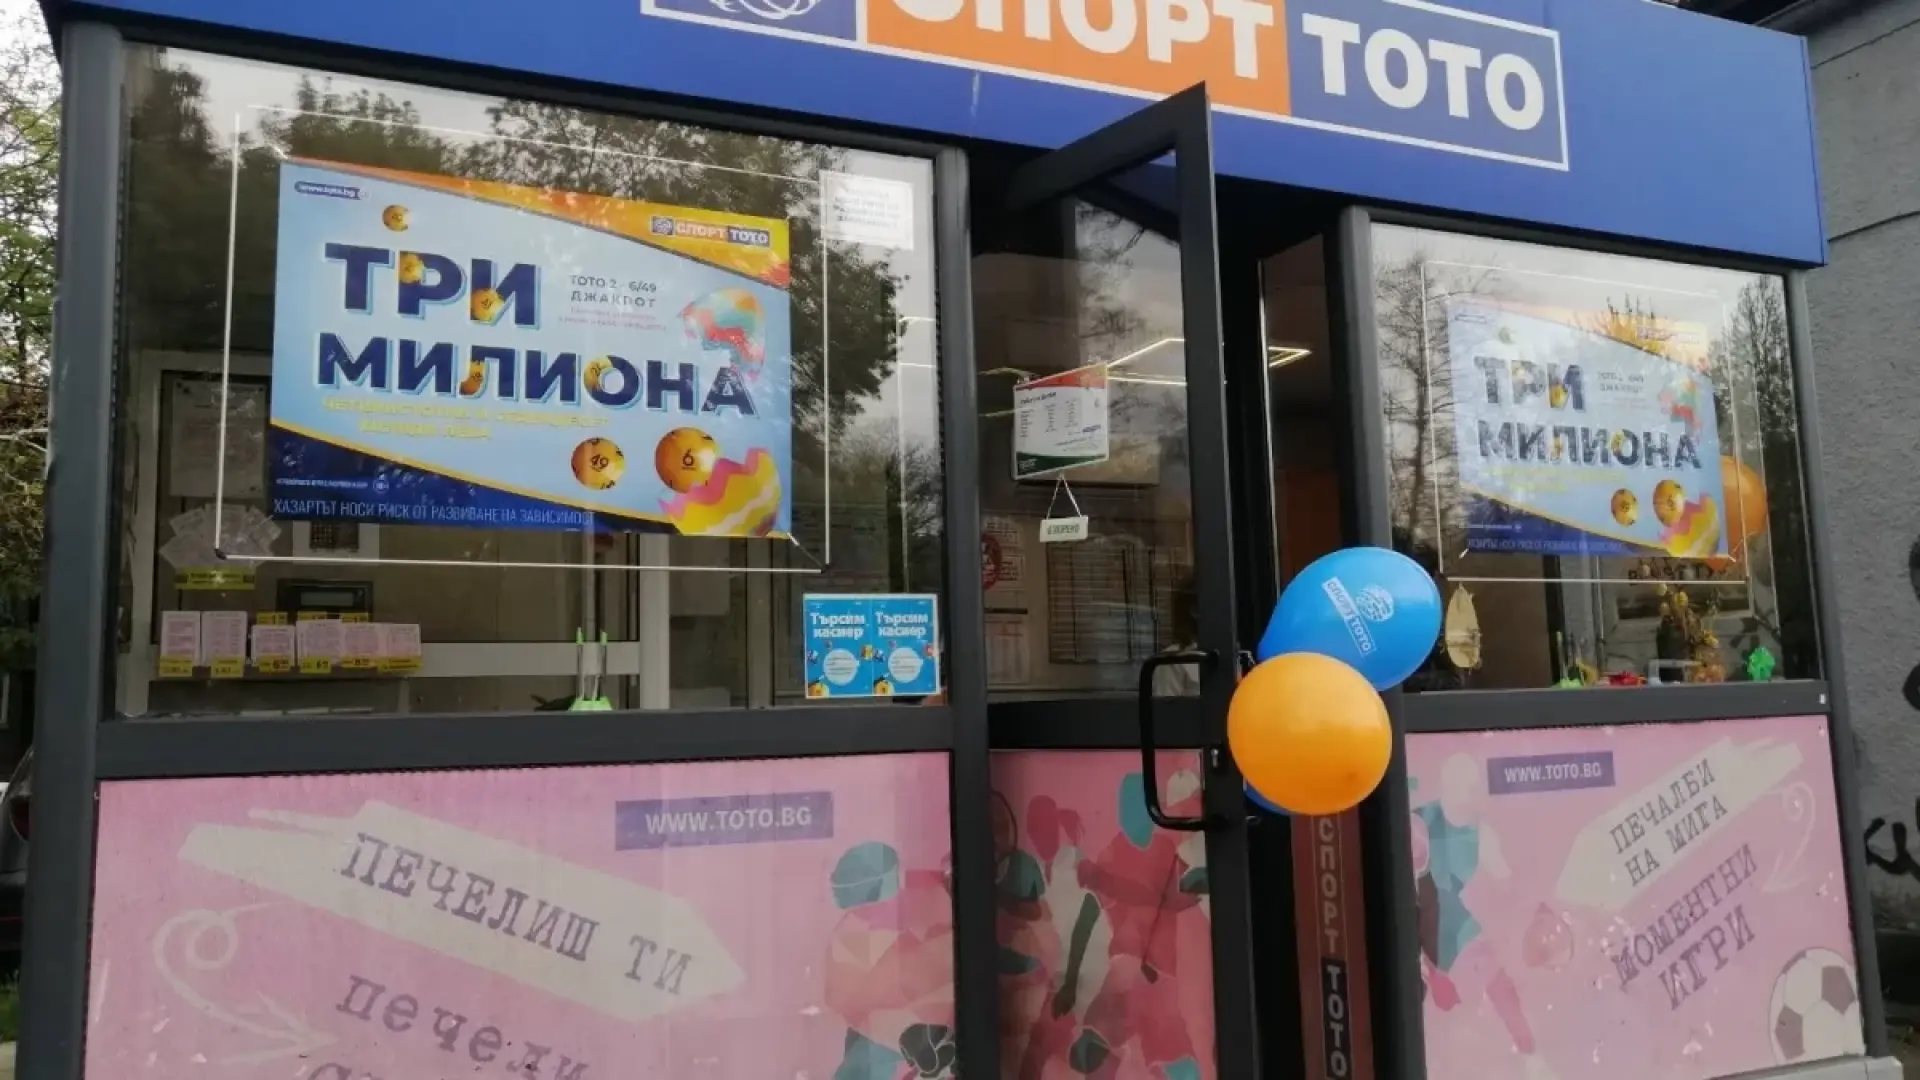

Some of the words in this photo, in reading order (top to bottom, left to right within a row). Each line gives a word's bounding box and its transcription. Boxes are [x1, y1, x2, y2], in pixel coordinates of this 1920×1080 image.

[889, 0, 1273, 80] ОРТ
[1303, 15, 1545, 131] ТОТО
[676, 224, 727, 241] СПОРТ
[729, 228, 769, 245] ТОТО
[324, 242, 538, 328] ТРИ
[569, 275, 605, 289] ТОТО
[609, 279, 617, 289] 2
[629, 281, 657, 293] 6/49
[570, 290, 657, 308] ДЖАКПОТ
[316, 331, 759, 418] МИЛИОНА
[1473, 355, 1586, 412] ТРИ
[1477, 419, 1702, 470] МИЛИОНА
[273, 499, 336, 516] ХАЗАРТЪТ
[341, 502, 375, 517] НОСИ
[379, 503, 409, 518] РИСК
[413, 505, 428, 519] ОТ
[432, 505, 499, 521] РАЗВИВАНЕ
[502, 508, 516, 521] НА
[1351, 617, 1372, 652] ТОТО
[645, 806, 813, 836] WWW.TOTO.BG
[1610, 758, 1717, 855] ПЕЧАЛБИ
[1623, 848, 1661, 887] НА
[1667, 795, 1729, 854] МИГА
[341, 832, 600, 963] ПЕЧЕЛИШ
[624, 935, 693, 995] ТИ
[1319, 817, 1340, 954] СПОРТ
[1610, 843, 1759, 987] МОМЕНТНИ
[1657, 904, 1756, 1012] ИГРИ
[1327, 964, 1348, 1078] ТОТО
